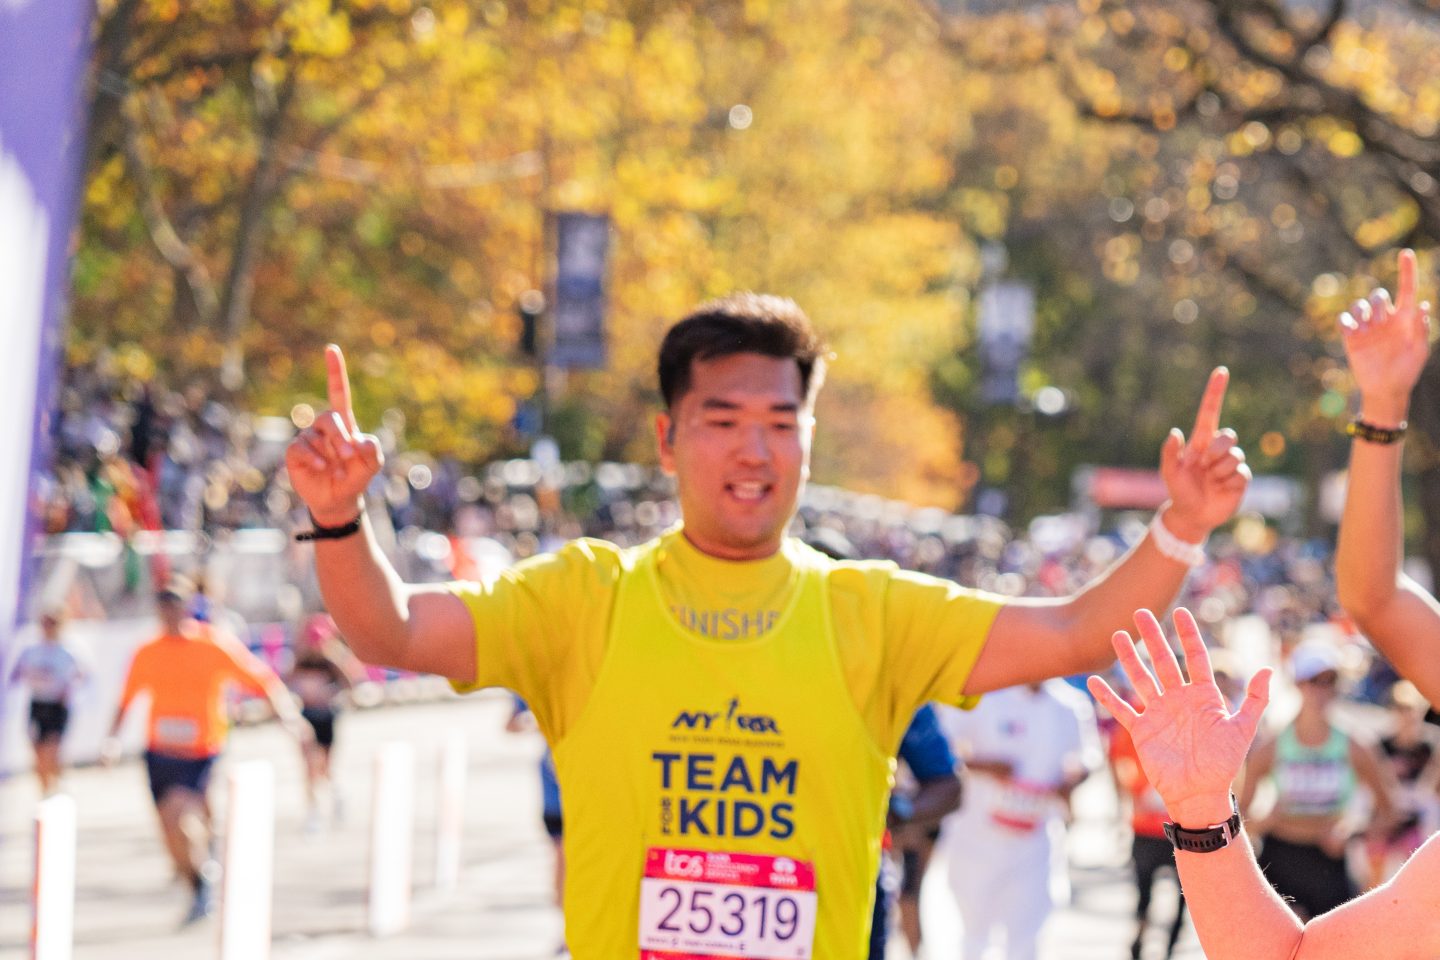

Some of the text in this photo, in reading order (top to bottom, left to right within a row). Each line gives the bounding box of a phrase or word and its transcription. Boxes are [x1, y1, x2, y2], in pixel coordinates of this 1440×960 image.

[652, 752, 799, 795] TEAM
[679, 799, 796, 839] KIDS
[664, 850, 704, 878] tcs
[657, 887, 800, 941] 25319
